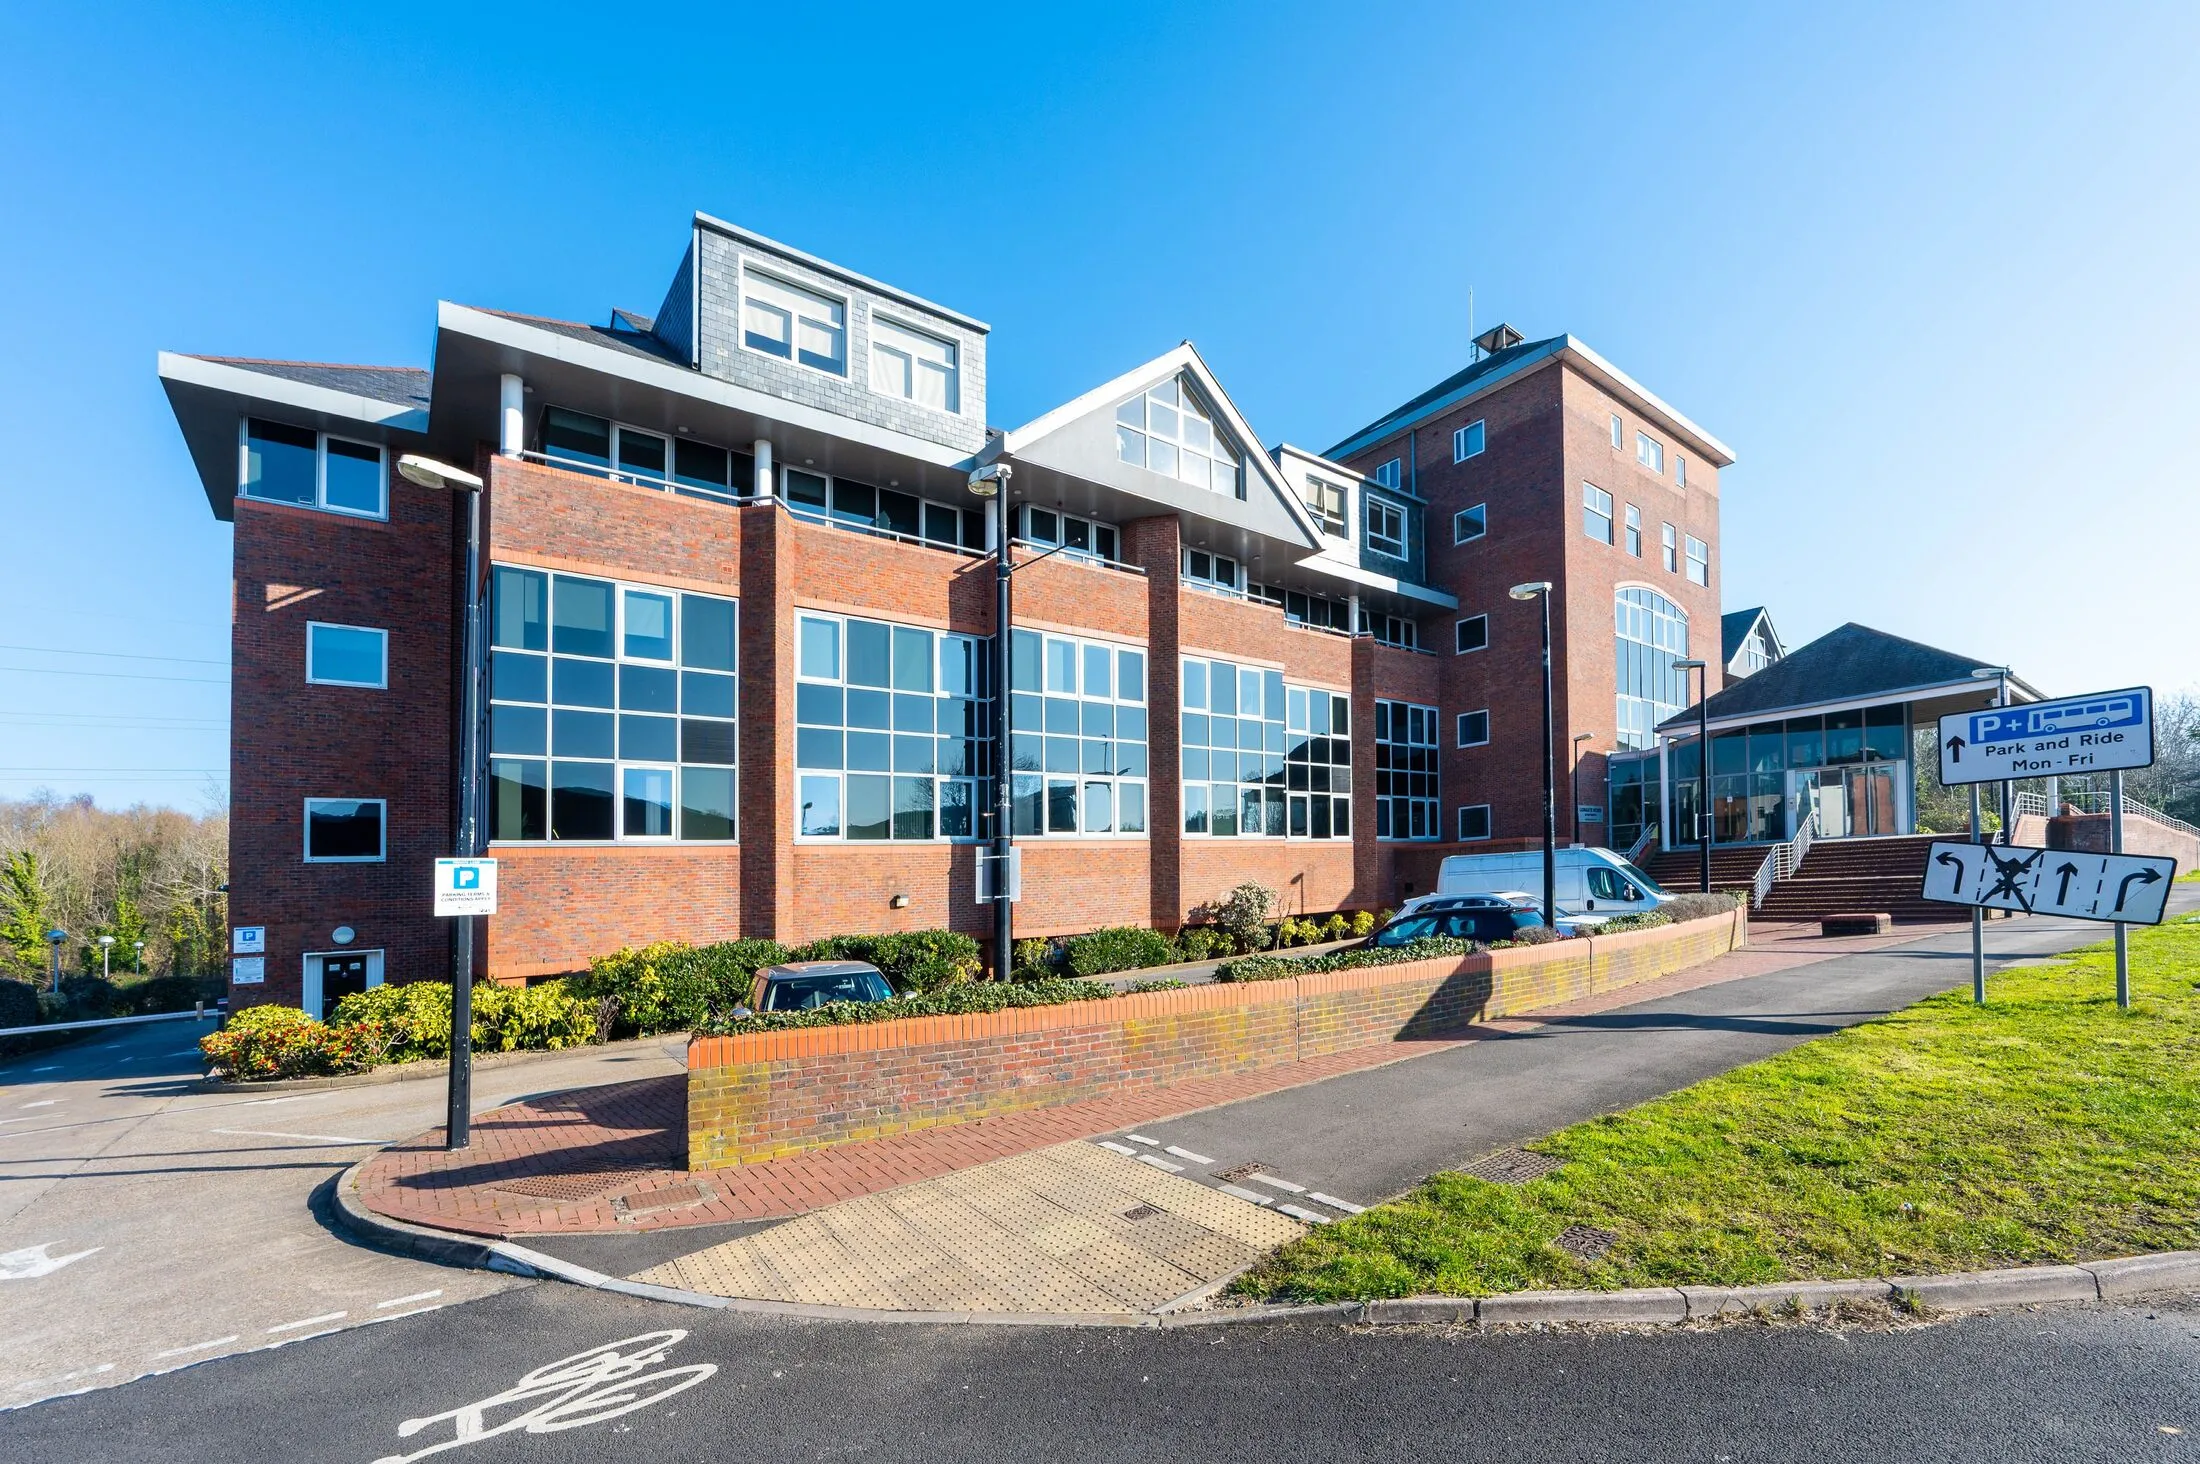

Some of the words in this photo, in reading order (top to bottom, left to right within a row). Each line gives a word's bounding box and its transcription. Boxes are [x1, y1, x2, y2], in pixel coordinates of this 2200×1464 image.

[1985, 742, 2025, 757] Park
[2034, 736, 2070, 751] and
[2080, 732, 2125, 746] Ride
[459, 870, 475, 887] P
[246, 932, 254, 940] P
